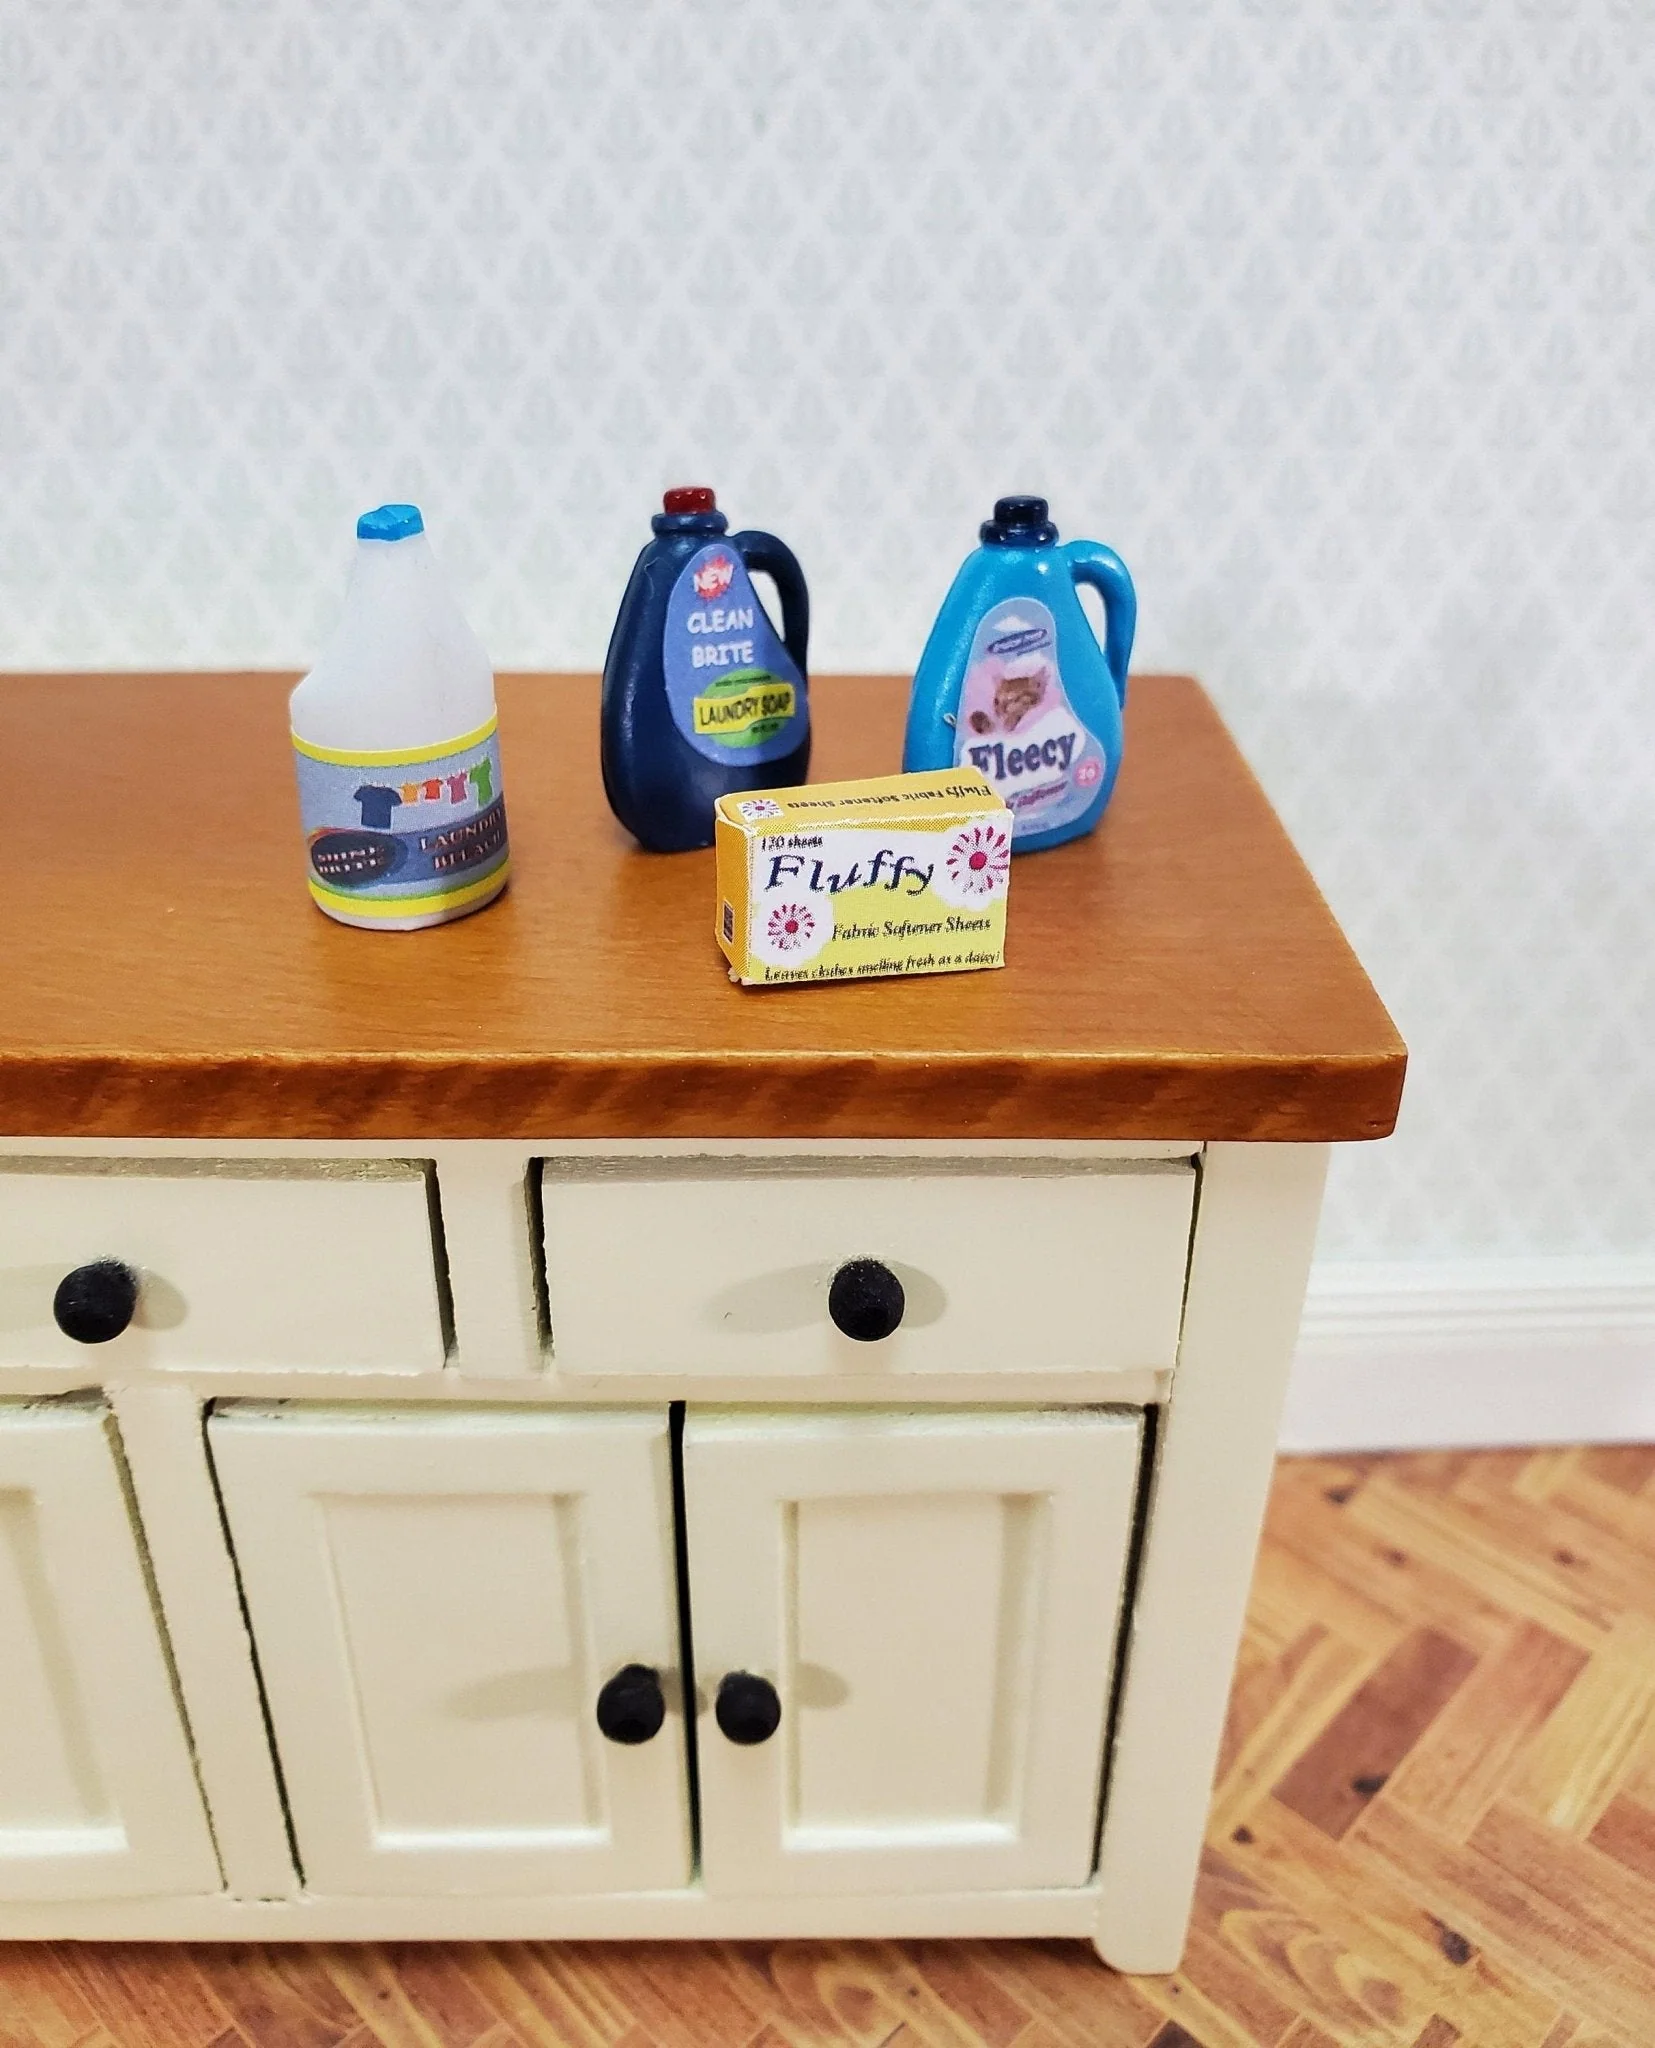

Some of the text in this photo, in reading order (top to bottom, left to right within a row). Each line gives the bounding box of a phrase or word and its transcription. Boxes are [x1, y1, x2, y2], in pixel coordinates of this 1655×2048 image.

[694, 563, 734, 592] NEW
[687, 608, 753, 634] CLEAN
[691, 640, 753, 668] BRITE
[700, 691, 790, 726] LAUNDRY SOAP
[968, 733, 1075, 780] Fleecy
[902, 790, 945, 801] Fabric
[946, 785, 991, 798] Fluffy
[764, 849, 934, 896] Fluffy
[832, 915, 991, 941] Fabric Softener Sheets
[905, 953, 935, 971] fresh
[938, 955, 951, 966] as
